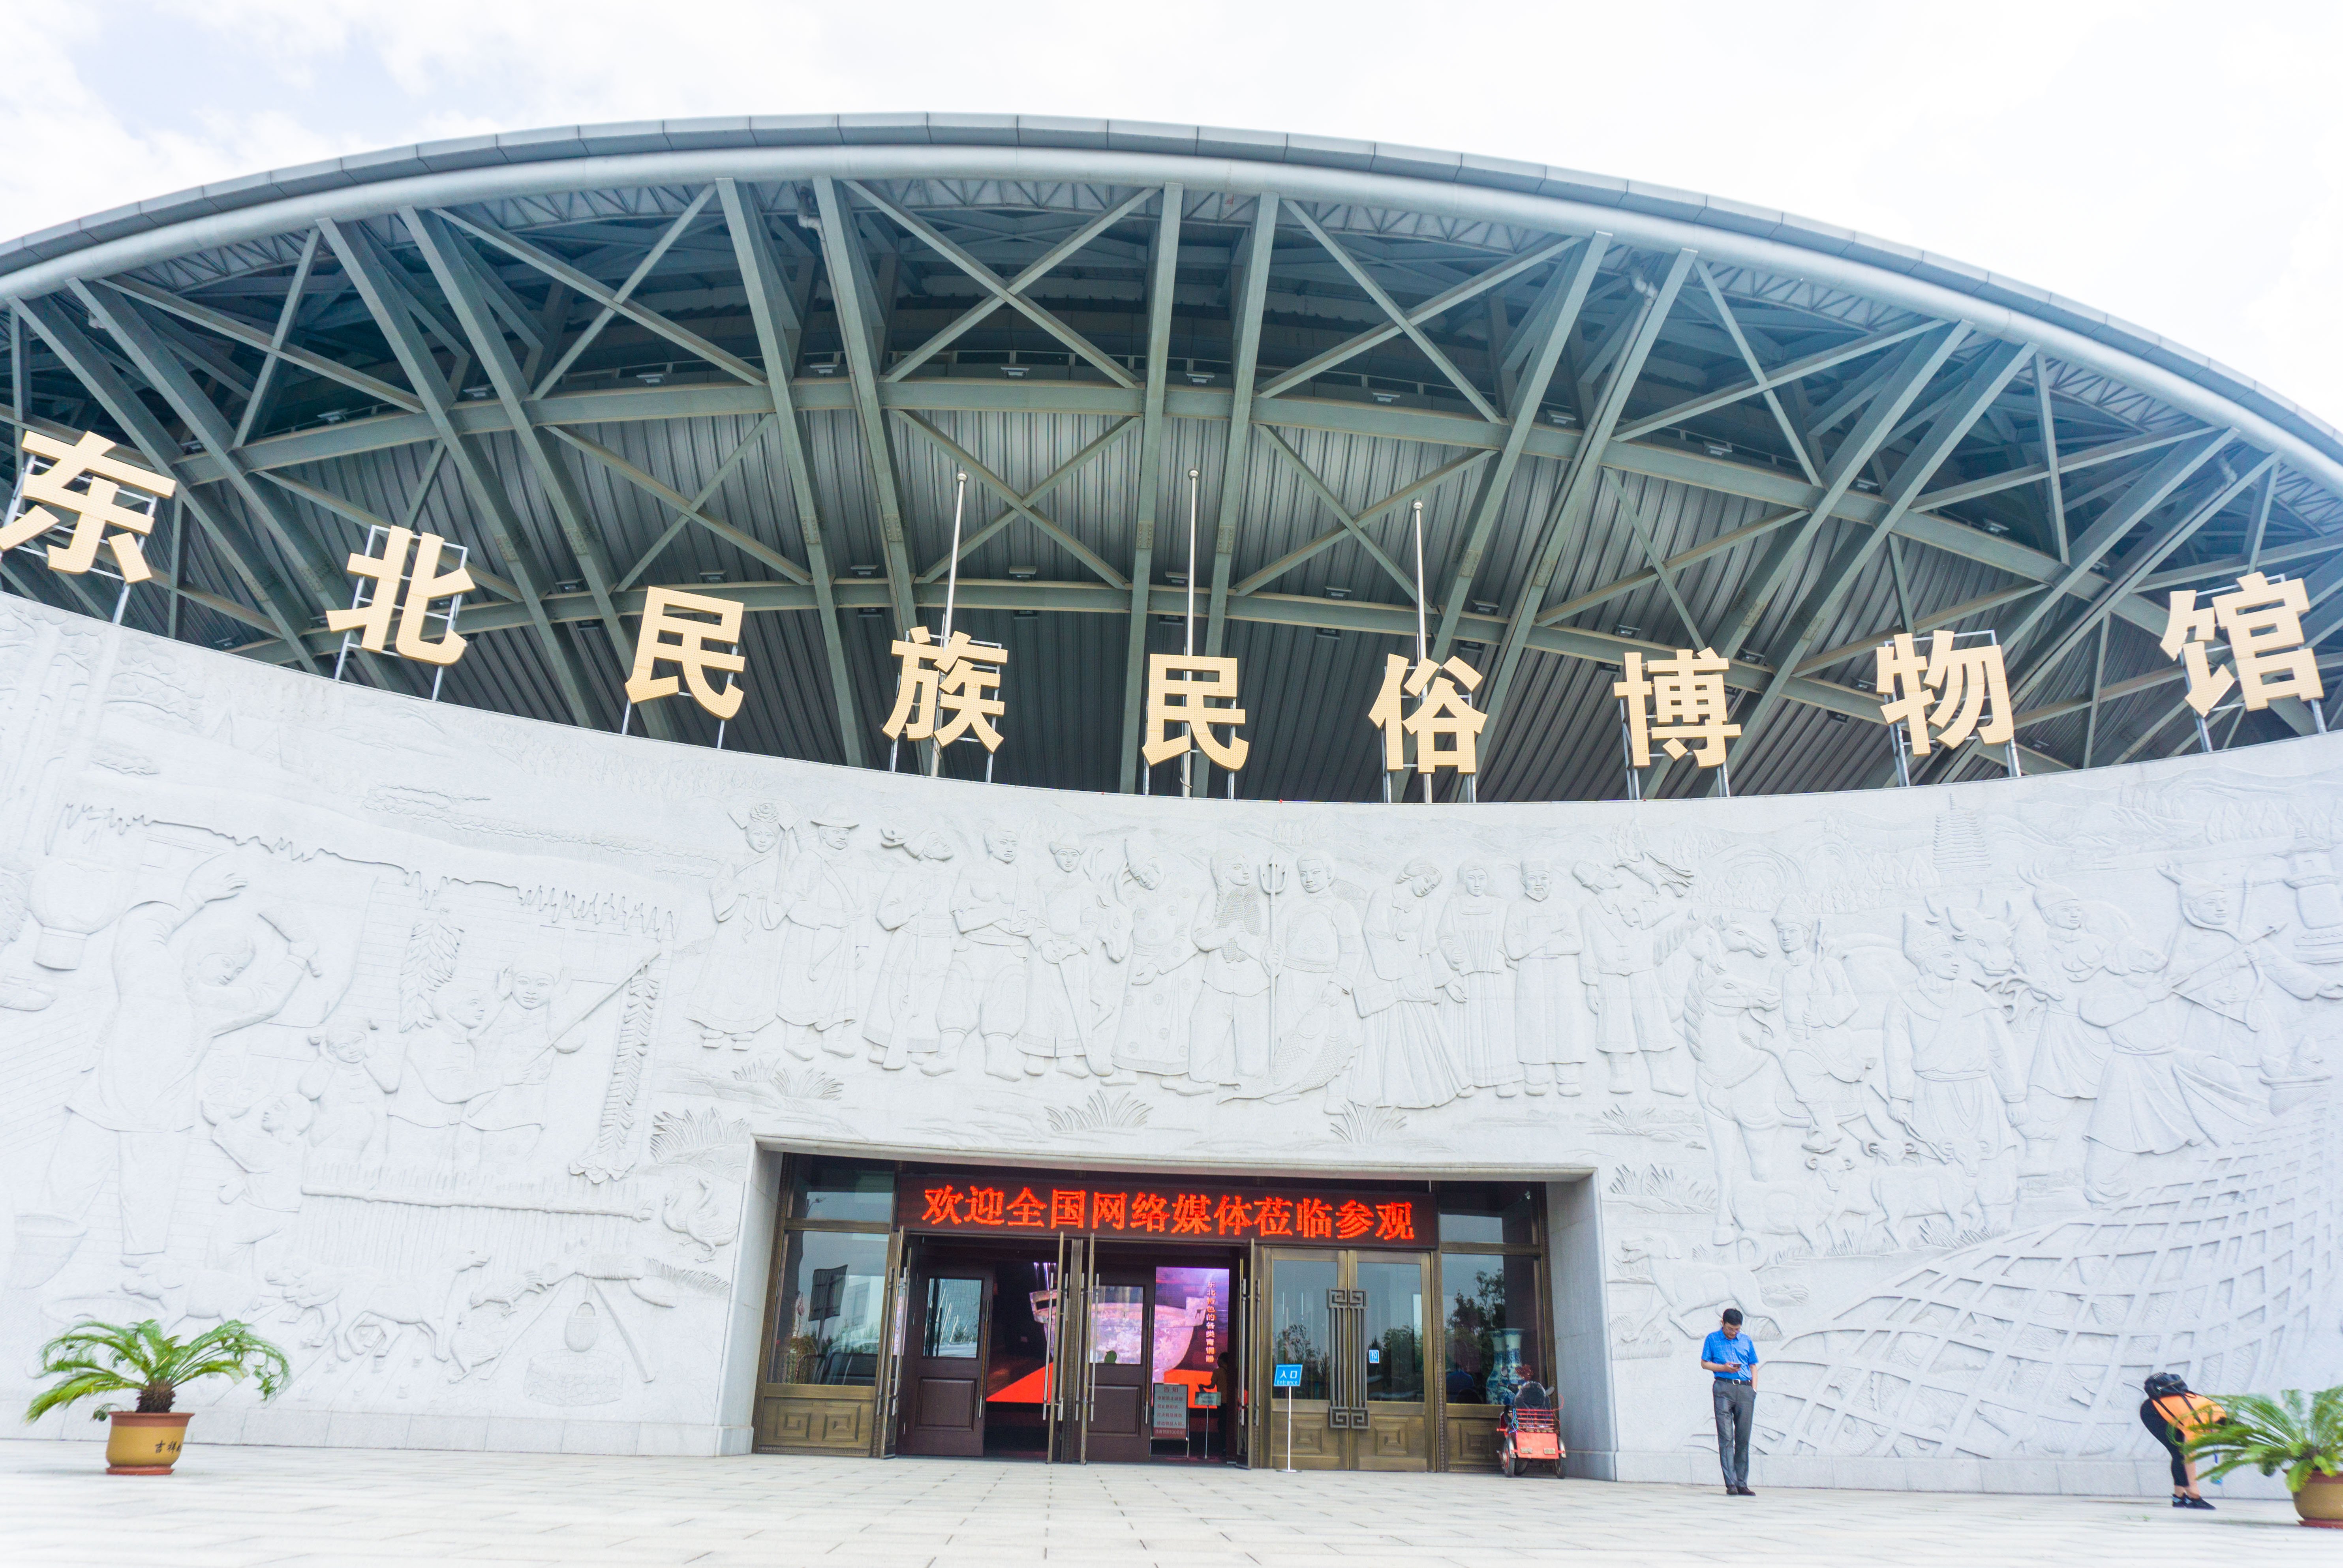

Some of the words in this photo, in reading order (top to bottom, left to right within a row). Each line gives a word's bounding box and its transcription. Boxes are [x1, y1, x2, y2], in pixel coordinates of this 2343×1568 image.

[0, 430, 2323, 774] 东北民族民俗博物馆
[921, 1185, 1415, 1241] 欢迎全国网络媒体莅临参观
[1279, 1370, 1297, 1379] 入口
